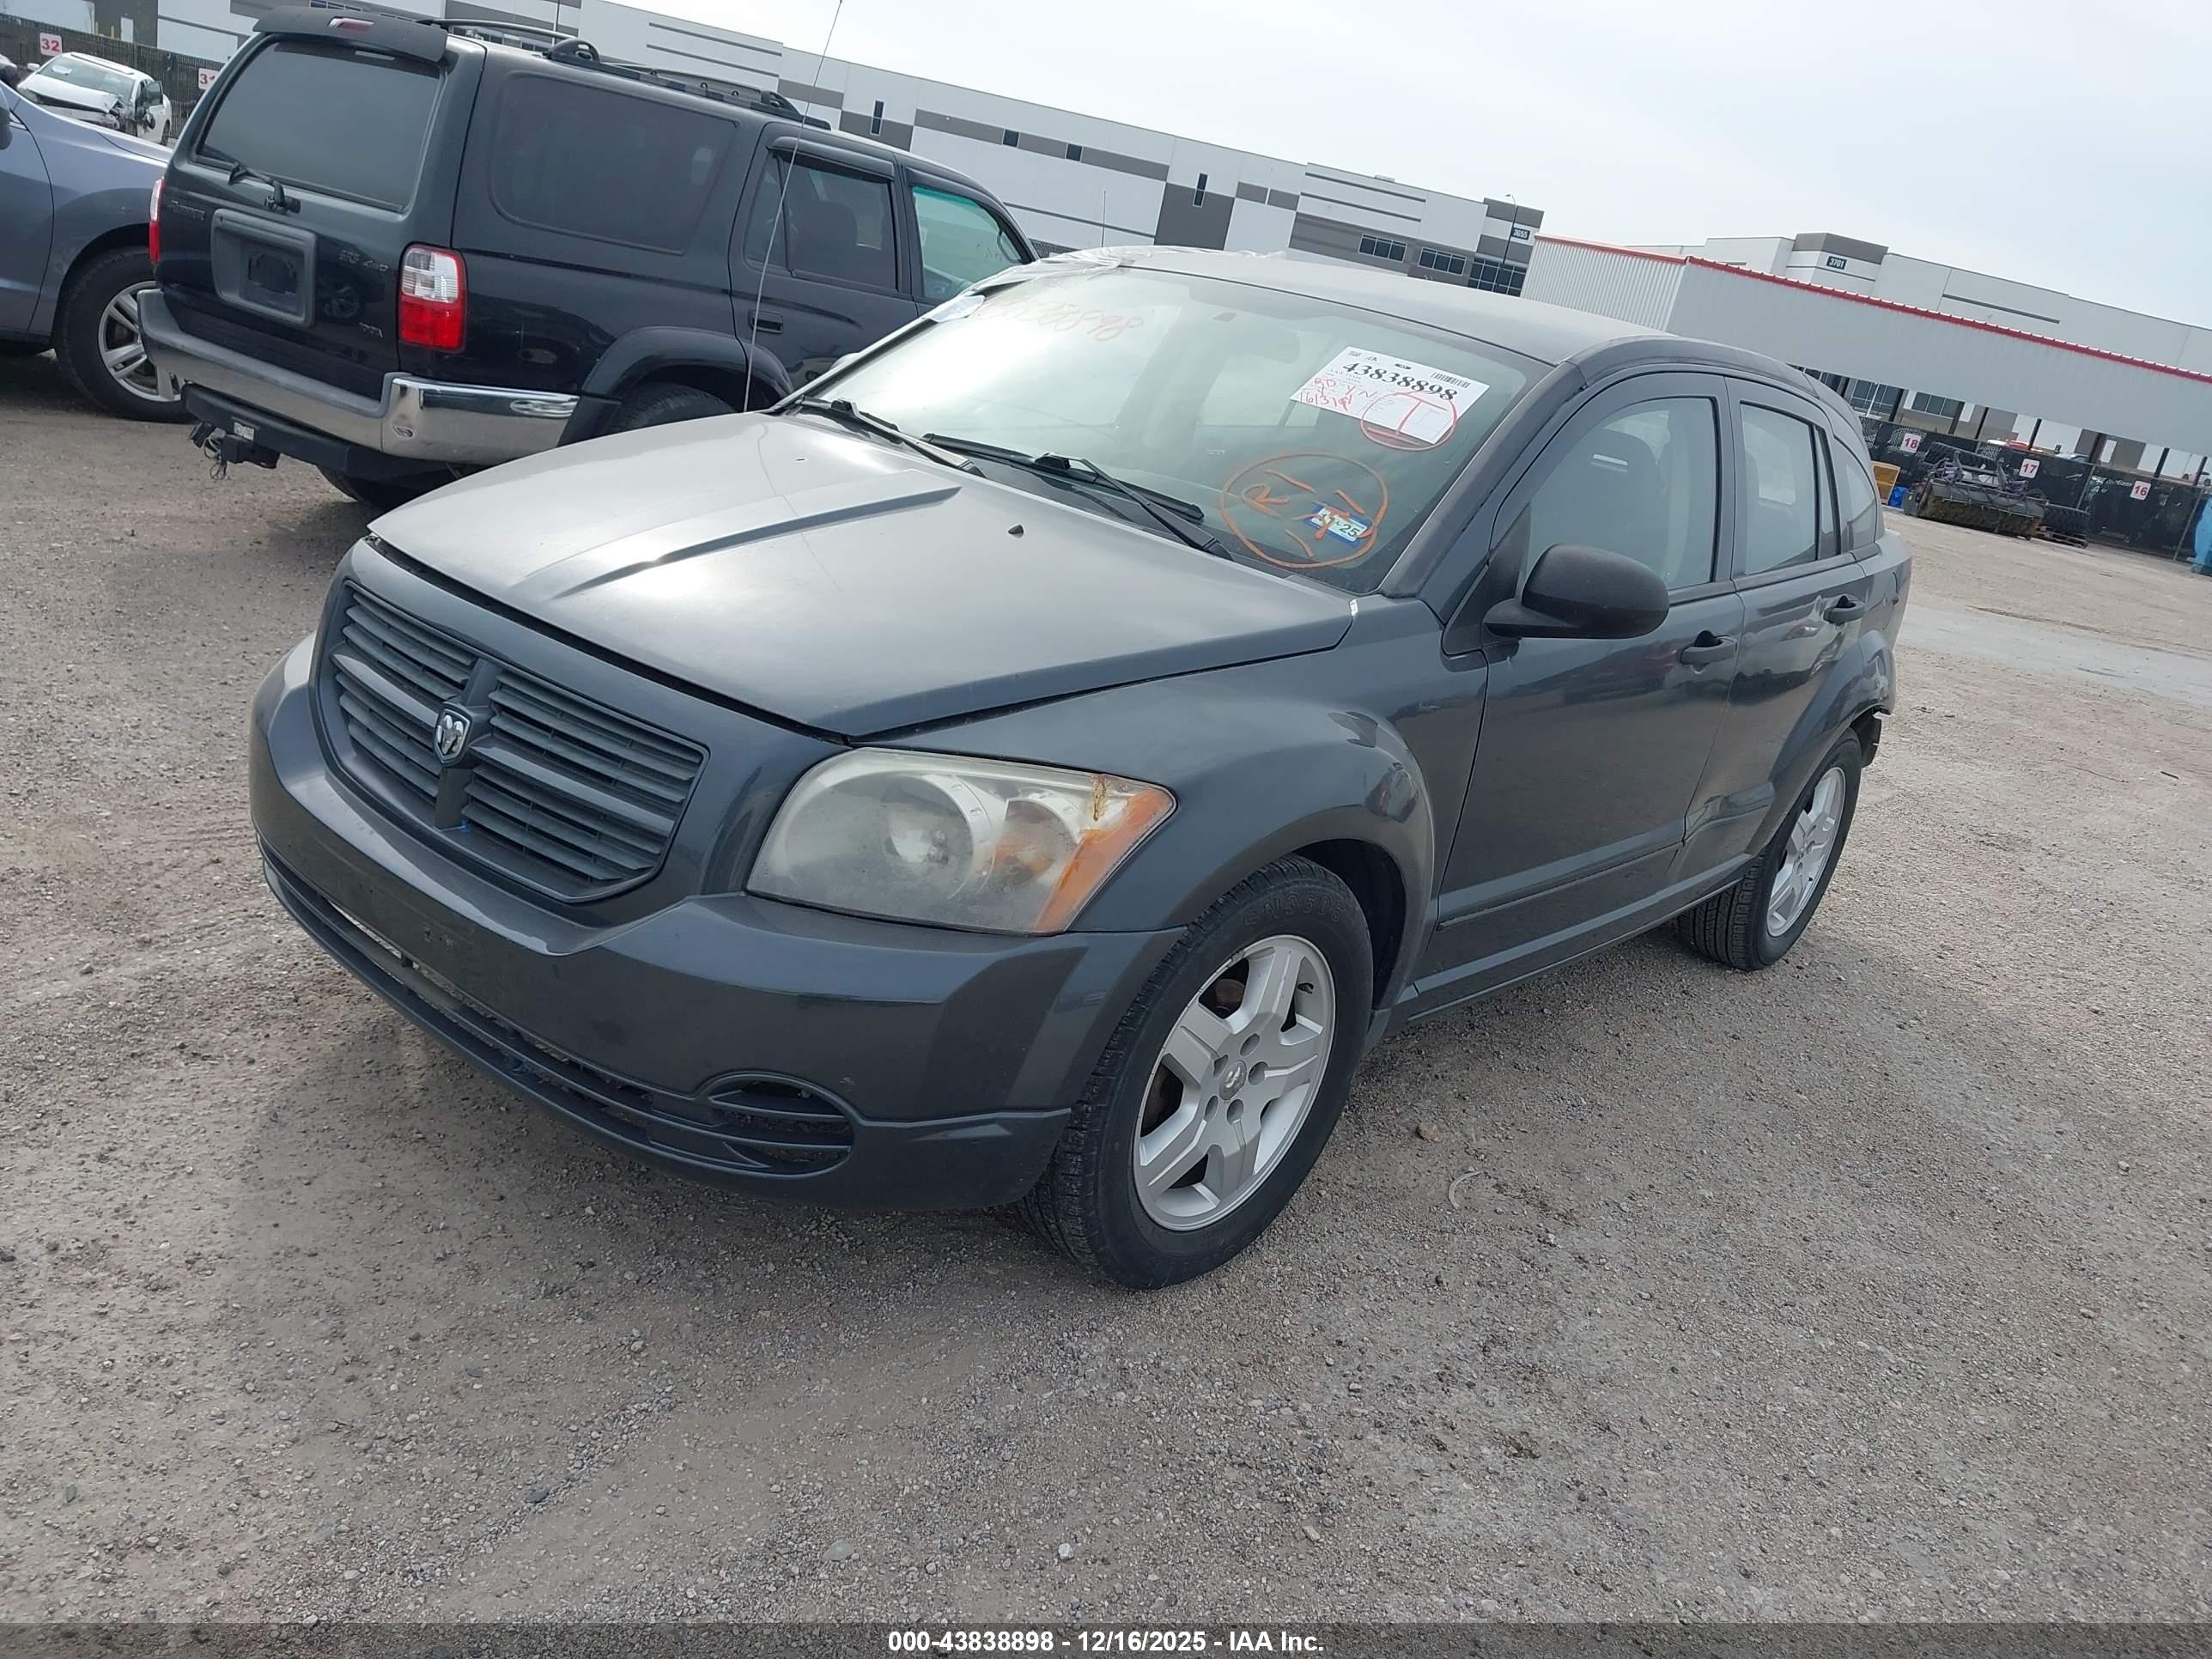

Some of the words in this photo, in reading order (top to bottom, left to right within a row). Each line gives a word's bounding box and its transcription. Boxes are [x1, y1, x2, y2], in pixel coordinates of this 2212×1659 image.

[41, 39, 60, 52] 32
[1513, 228, 1528, 238] 3655
[1829, 258, 1844, 269] 3701
[1342, 362, 1459, 401] 43838898
[1905, 438, 1918, 449] 18
[2023, 463, 2038, 473] 17
[2135, 485, 2148, 496] 16
[1340, 523, 1361, 538] 25
